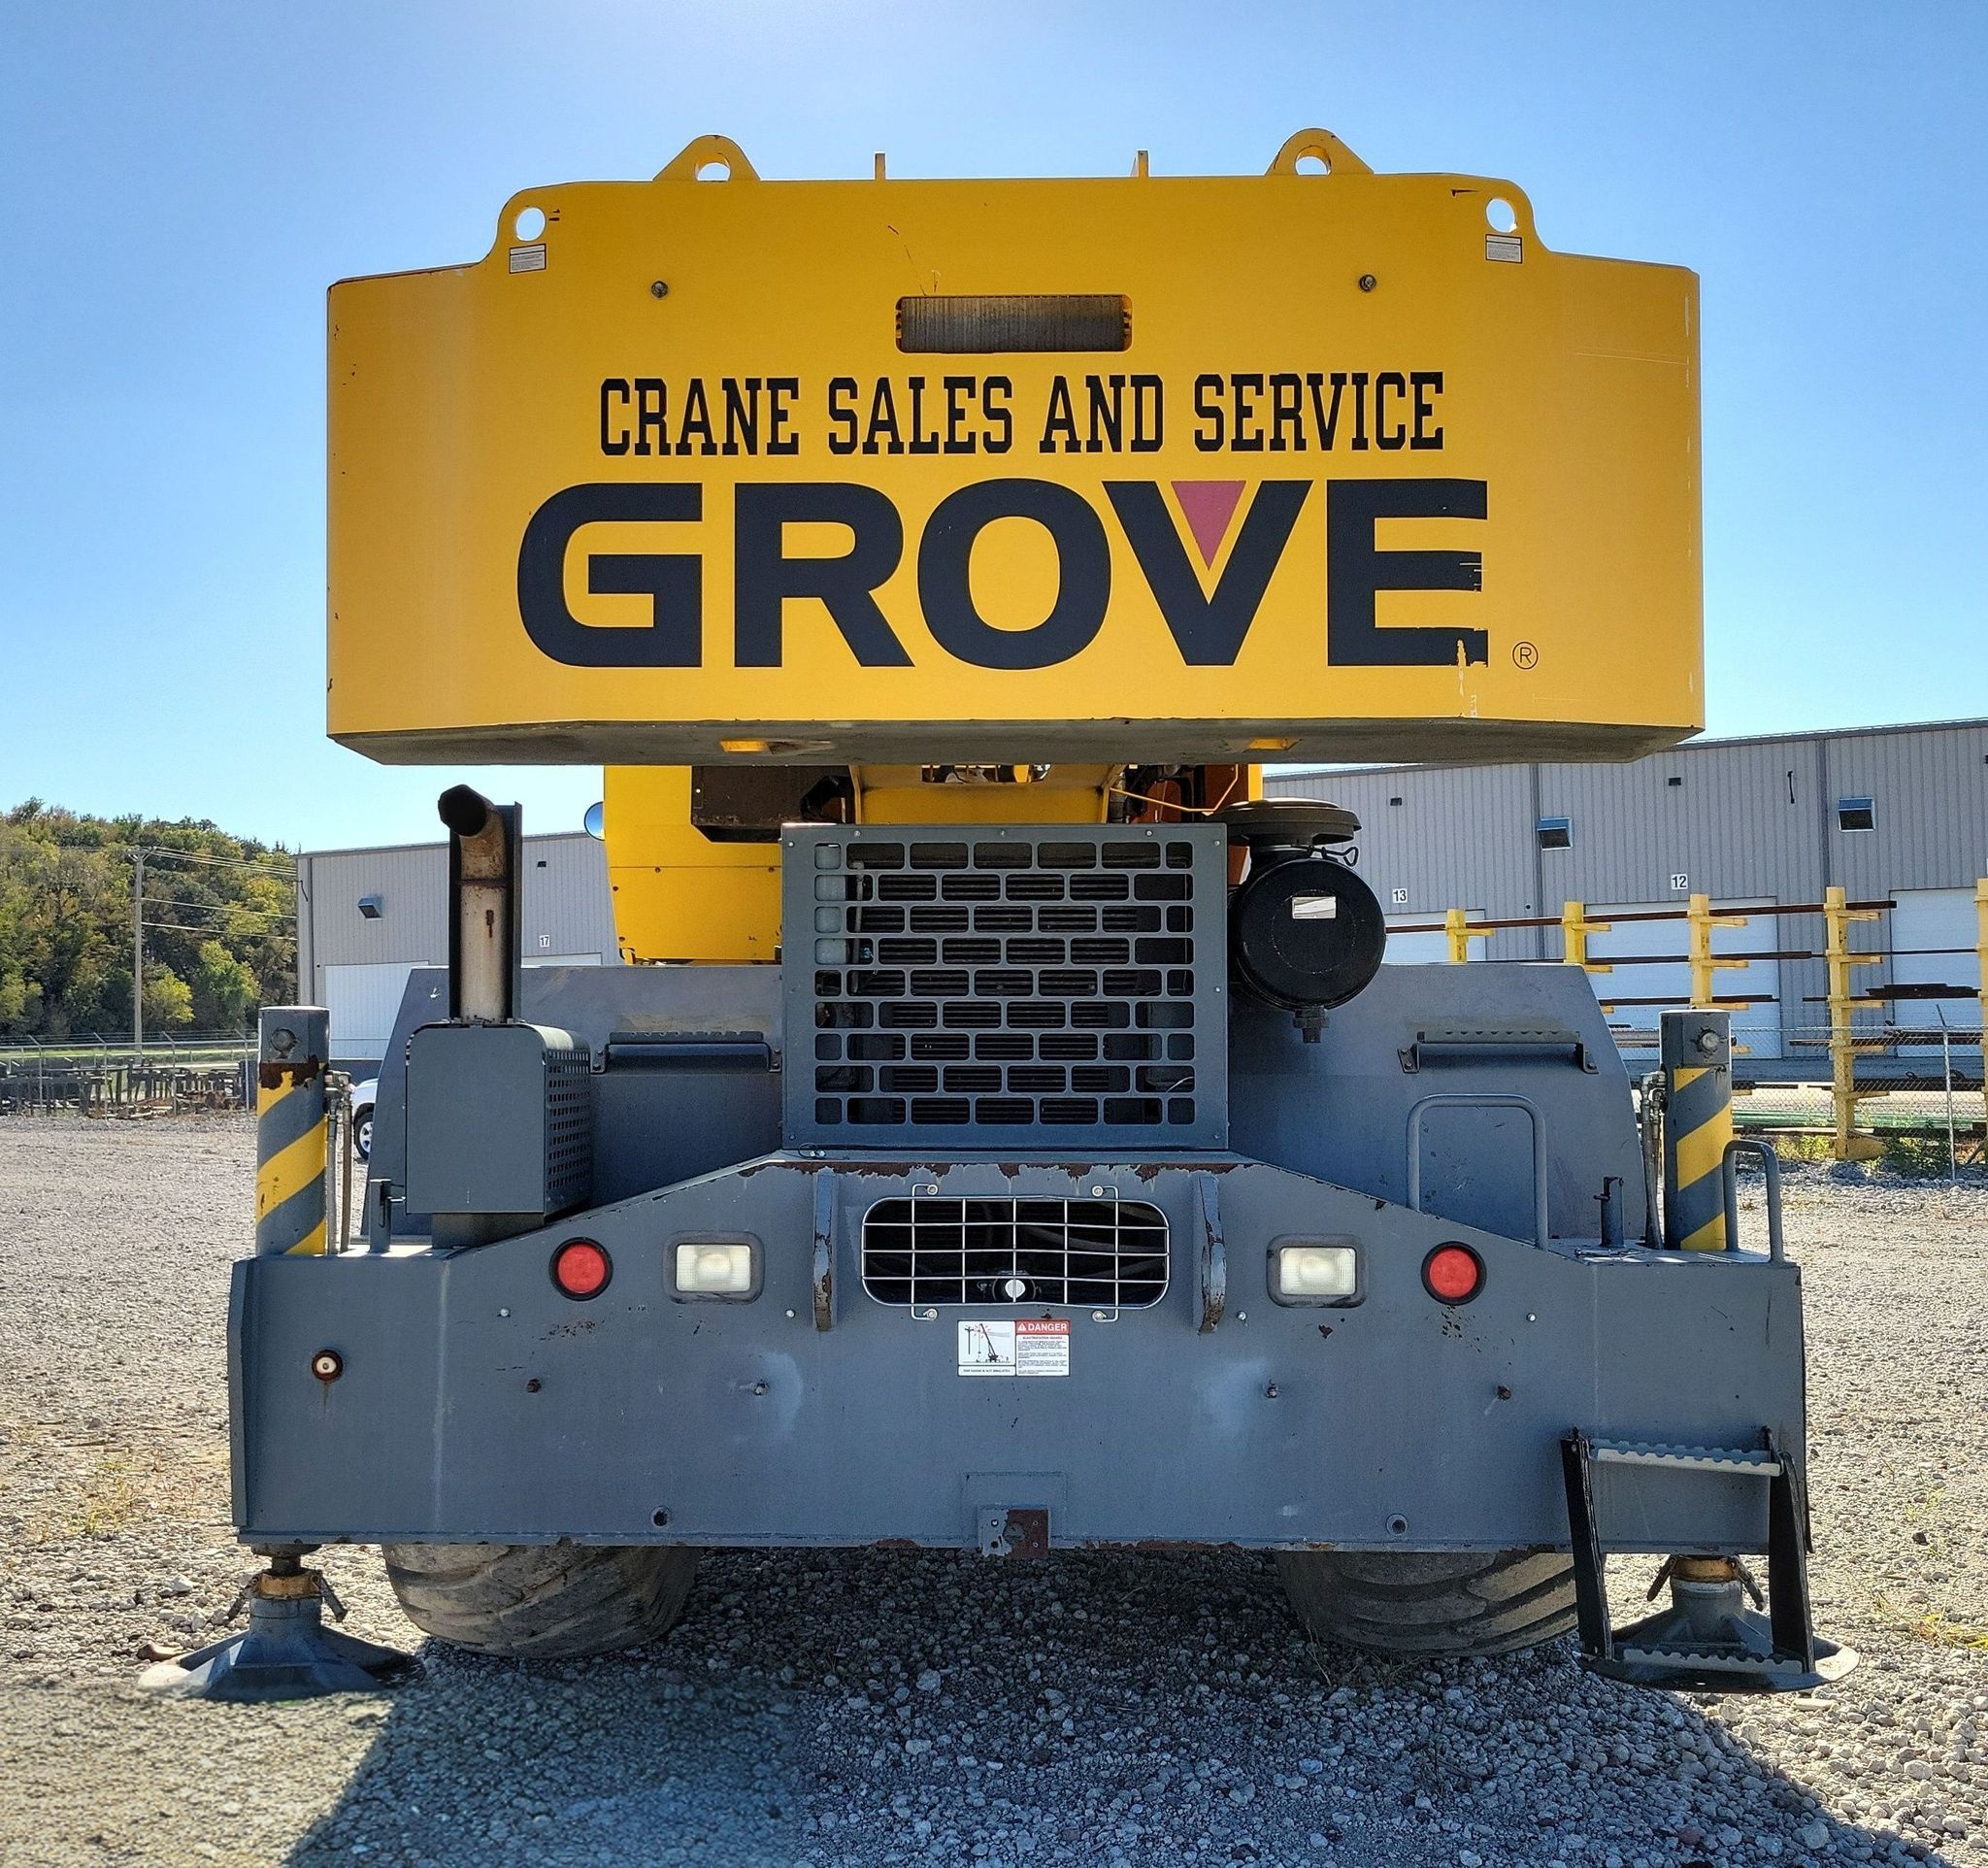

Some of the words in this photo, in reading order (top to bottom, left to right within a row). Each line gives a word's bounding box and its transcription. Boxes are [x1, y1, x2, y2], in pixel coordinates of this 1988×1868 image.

[600, 377, 800, 456] CRANE
[828, 376, 1012, 455] SALES
[1039, 374, 1164, 453] AND
[1194, 371, 1443, 452] SERVICE
[516, 478, 1489, 671] GROVE
[1672, 875, 1687, 888] 12
[1393, 889, 1407, 902] 13
[540, 936, 549, 946] 17
[1027, 1322, 1068, 1332] DANGER
